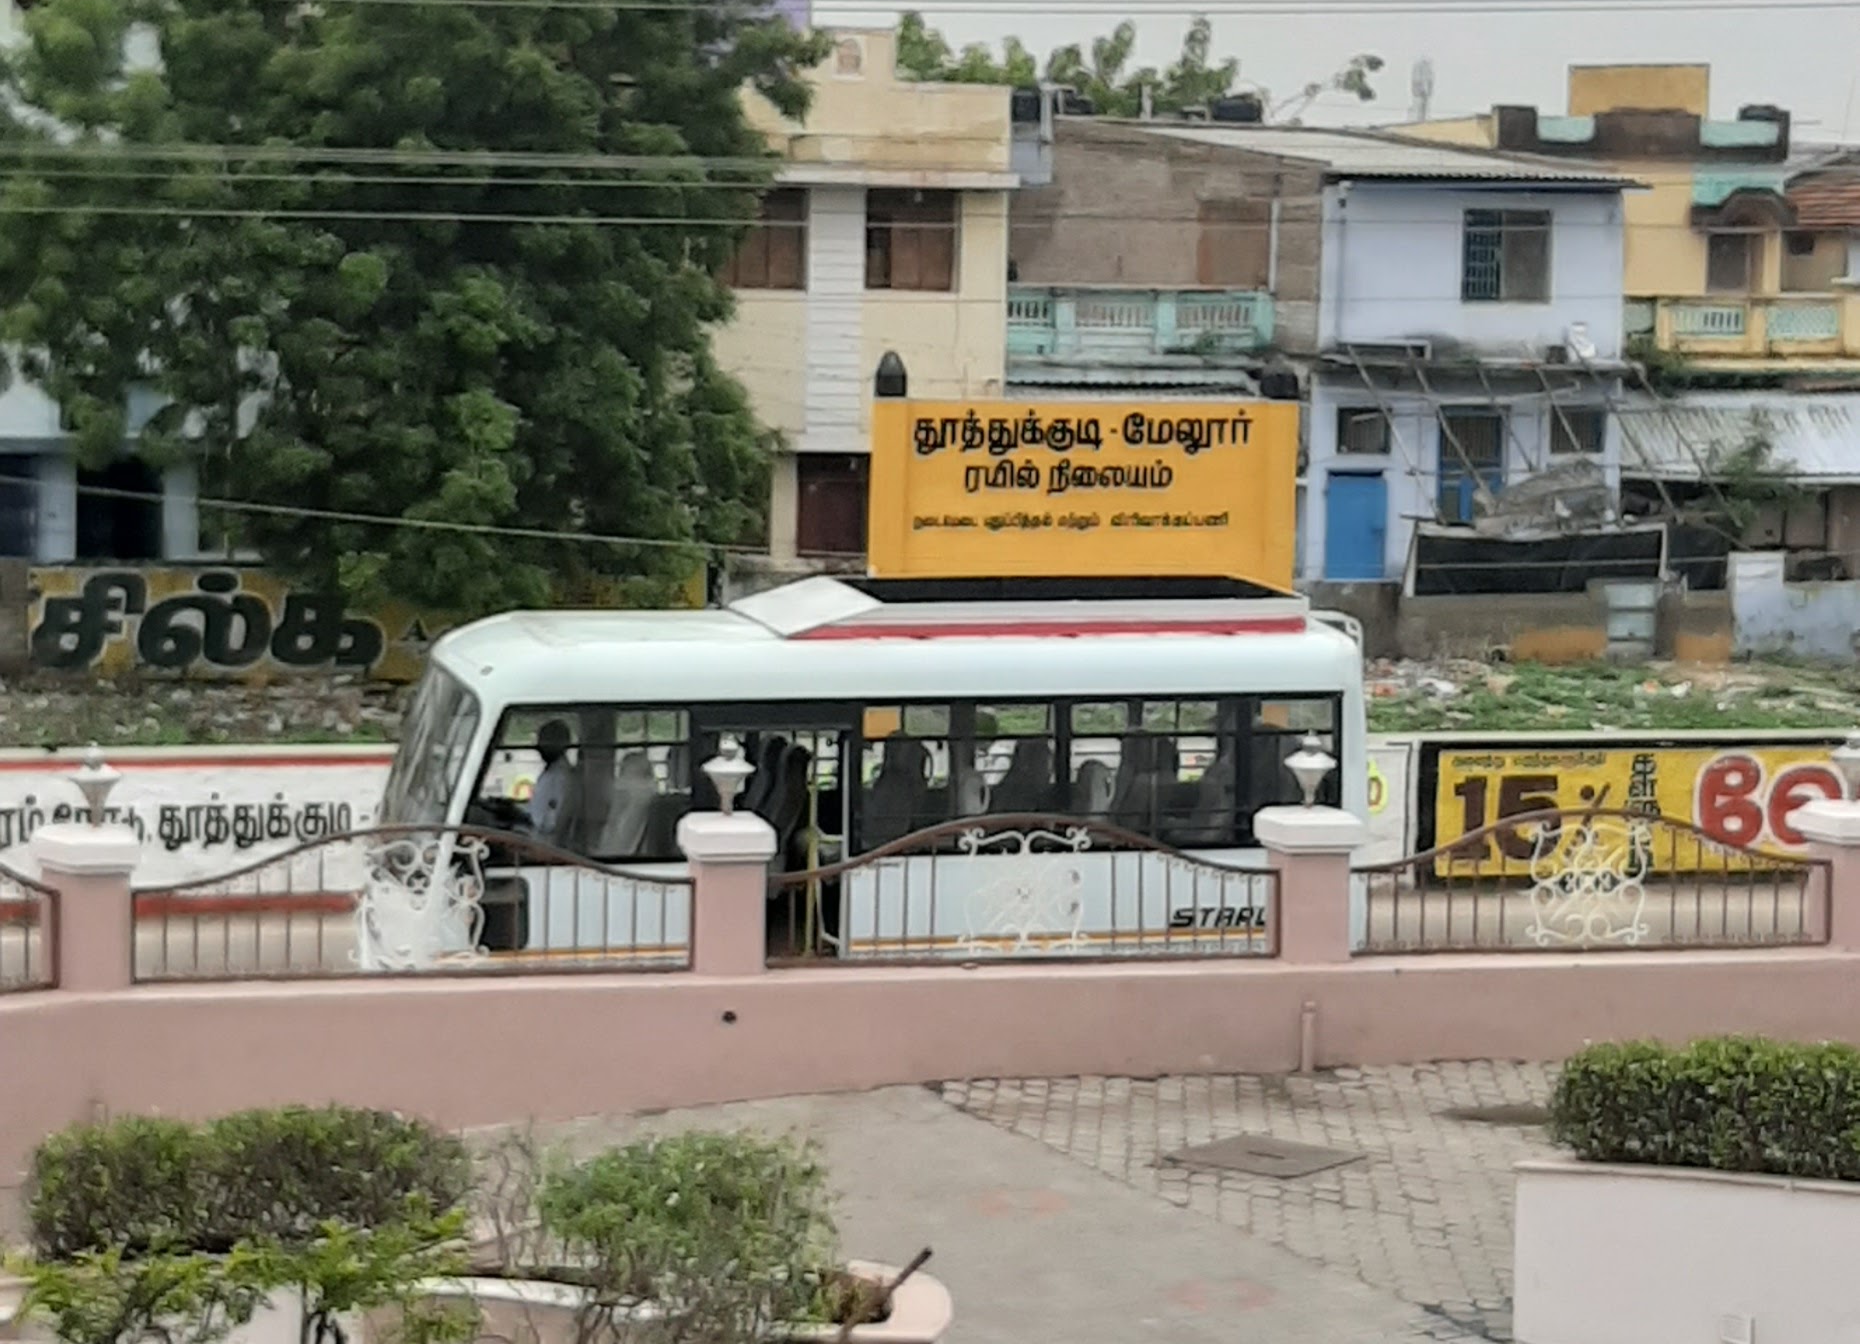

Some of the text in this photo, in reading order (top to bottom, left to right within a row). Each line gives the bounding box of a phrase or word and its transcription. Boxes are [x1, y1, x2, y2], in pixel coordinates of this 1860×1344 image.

[914, 409, 1101, 455] தூத்துக்குடி
[1122, 410, 1252, 454] மேலூர்
[964, 460, 1173, 494] ரயில் நிலையம்
